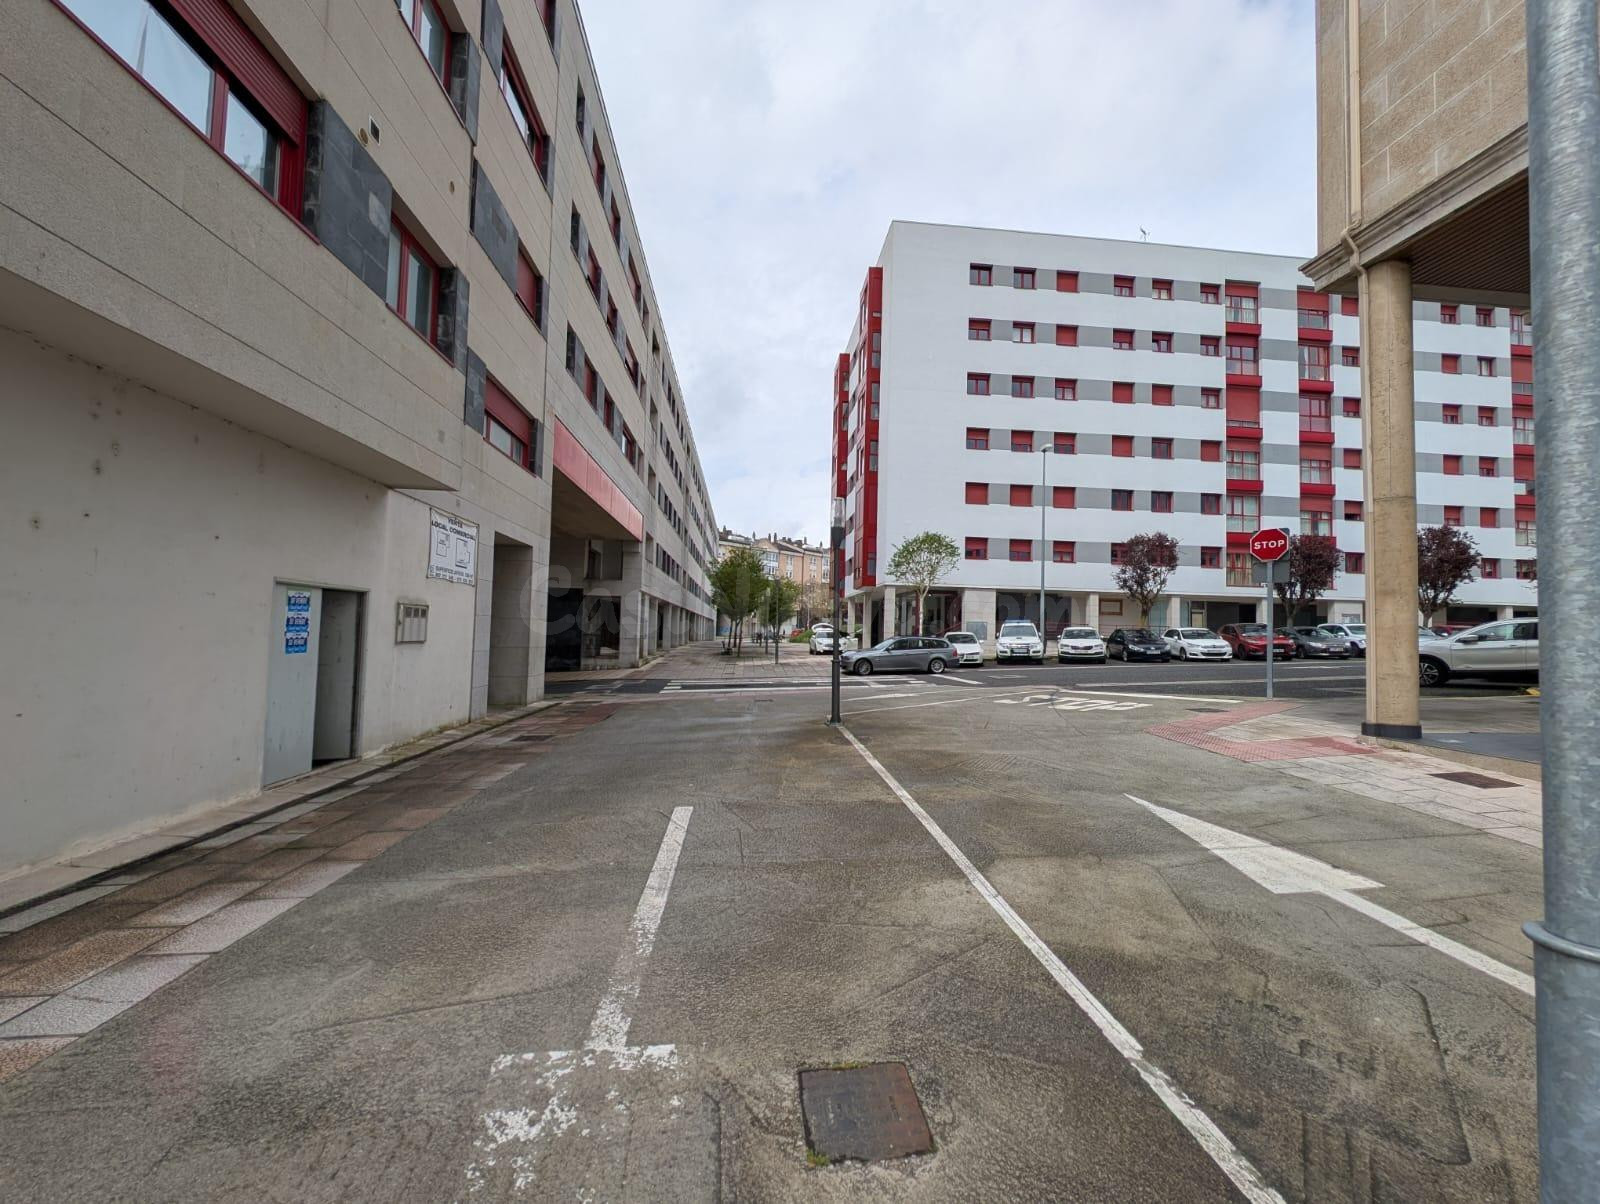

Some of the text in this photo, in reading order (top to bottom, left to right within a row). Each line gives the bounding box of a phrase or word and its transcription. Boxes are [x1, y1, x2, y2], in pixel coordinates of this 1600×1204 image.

[431, 520, 448, 531] LOCAL
[1253, 539, 1285, 550] STOP
[993, 694, 1153, 712] STOP
